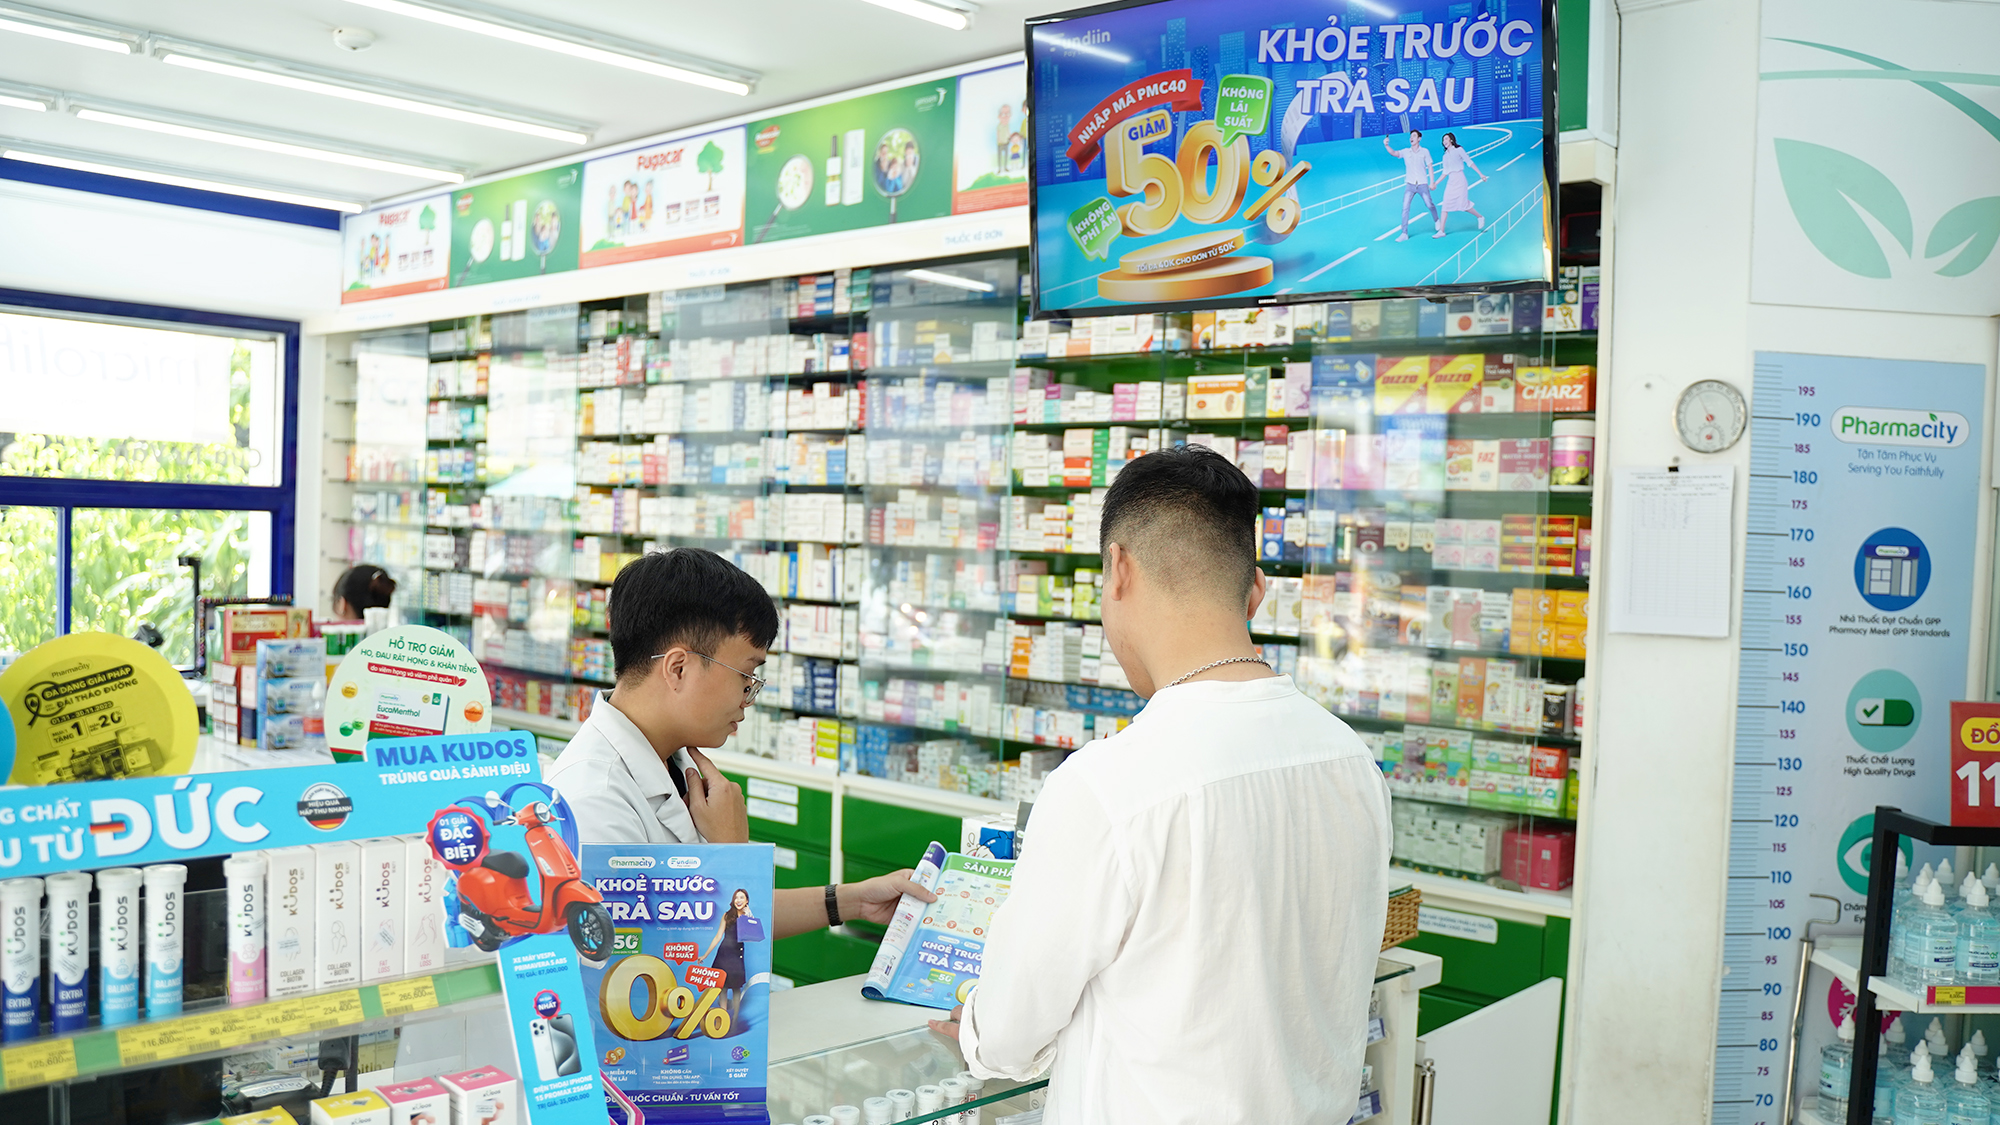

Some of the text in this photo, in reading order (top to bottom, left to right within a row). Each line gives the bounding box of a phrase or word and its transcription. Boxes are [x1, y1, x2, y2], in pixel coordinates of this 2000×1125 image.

[1257, 12, 1534, 63] KHỎE TRƯỚC
[1222, 85, 1264, 100] KHÔNG
[1296, 67, 1475, 114] TRẢ SAU
[1077, 79, 1187, 146] NHẬP MÃ PMC40
[1230, 99, 1248, 113] LÃI
[1224, 114, 1254, 129] SUẤT
[1127, 117, 1167, 141] GIẢM
[1075, 202, 1111, 234] KHÔNG
[1080, 226, 1100, 246] PHÍ
[1381, 374, 1418, 385] DIZZO
[1434, 373, 1471, 384] DIZZO
[1521, 384, 1585, 400] CHARZ
[1798, 386, 1816, 397] 195
[1795, 413, 1821, 427] 190
[1841, 412, 1958, 444] Pharmacity
[1794, 443, 1811, 454] 185
[1857, 448, 1937, 463] Tận Tâm Phục Vụ
[1793, 470, 1818, 485] 180
[1847, 462, 1945, 479] Serving You Faithfully
[1791, 500, 1808, 511] 175
[1790, 528, 1814, 542] 170
[1788, 556, 1805, 568] 165
[1787, 585, 1812, 600] 160
[1785, 614, 1802, 625] 155
[1839, 613, 1941, 627] Nhà Thuốc Đạt Chuẩn GPP
[1829, 625, 1951, 637] Pharmacy Meet GPP Standards
[389, 635, 455, 659] HỖ TRỢ GIẢM
[1783, 643, 1809, 657] 150
[361, 649, 478, 675] HO, ĐAU RÁT HỌNG & KHÀN TIẾNG
[51, 662, 91, 679] Pharmacity
[370, 664, 379, 672] do
[379, 665, 393, 674] viêm
[393, 667, 406, 678] họng
[407, 669, 414, 678] và
[414, 670, 427, 679] viêm
[427, 672, 439, 683] phế
[1782, 672, 1799, 683] 145
[61, 680, 86, 694] DẠNG
[86, 673, 106, 687] GIẢI
[106, 666, 132, 681] PHÁP
[74, 688, 102, 704] THÁO
[104, 678, 138, 695] ĐƯỜNG
[377, 704, 421, 718] EucaMenthol
[1780, 700, 1806, 714] 140
[71, 721, 82, 737] 1
[1779, 729, 1796, 740] 135
[54, 733, 74, 745] TẶNG
[376, 738, 529, 767] MUA KUDOS
[1845, 753, 1869, 764] Thuốc
[1870, 753, 1889, 764] Chất
[1777, 757, 1802, 771] 130
[378, 762, 531, 786] TRÚNG QUÀ SÀNH ĐIỆU
[1843, 767, 1916, 778] High Quality Drugs
[1776, 786, 1793, 797] 125
[20, 797, 82, 823] CHẤT
[308, 800, 325, 808] HIỆU
[314, 807, 328, 815] THU
[328, 805, 353, 814] NHANH
[89, 777, 271, 857] ĐỨC
[439, 814, 468, 827] 01 GIẢI
[1774, 814, 1799, 828] 120
[440, 825, 474, 844] ĐẶC
[30, 826, 85, 863] TỪ
[1772, 843, 1787, 853] 115
[444, 844, 477, 862] BIỆT
[611, 858, 653, 868] Pharmacity
[595, 874, 715, 892] KHOẺ TRƯỚC
[1771, 871, 1792, 884] 110
[657, 901, 714, 921] SAU
[1769, 899, 1785, 910] 105
[1767, 927, 1791, 941] 100
[665, 943, 694, 952] KHÔNG
[421, 953, 429, 961] FAT
[513, 951, 556, 964] XE MÁY VESPA
[665, 951, 694, 960] LÃI SUẤT
[918, 952, 950, 969] TRẢ
[1764, 955, 1778, 966] 95
[327, 962, 352, 971] COLLAGEN
[378, 965, 391, 974] LOSS
[419, 958, 432, 968] LOSS
[514, 961, 548, 972] PRIMAVERA
[552, 957, 567, 966] ABS
[280, 969, 305, 978] COLLAGEN
[538, 965, 569, 977] 87,000,000
[692, 967, 720, 979] KHÔNG
[61, 989, 84, 1000] EXTRA
[1763, 983, 1782, 996] 90
[6, 998, 32, 1009] EXTRA
[598, 955, 731, 1041] 0%
[538, 1001, 557, 1011] NHẤT
[1761, 1011, 1774, 1021] 85
[1759, 1038, 1778, 1052] 80
[1756, 1067, 1770, 1077] 75
[533, 1075, 593, 1095] ĐIỆN THOẠI IPHONE
[543, 1089, 572, 1100] PROMAX
[572, 1083, 593, 1093] 256GB
[537, 1093, 590, 1111] TRỊ GIÁ: 35,000,000
[1755, 1094, 1774, 1107] 70
